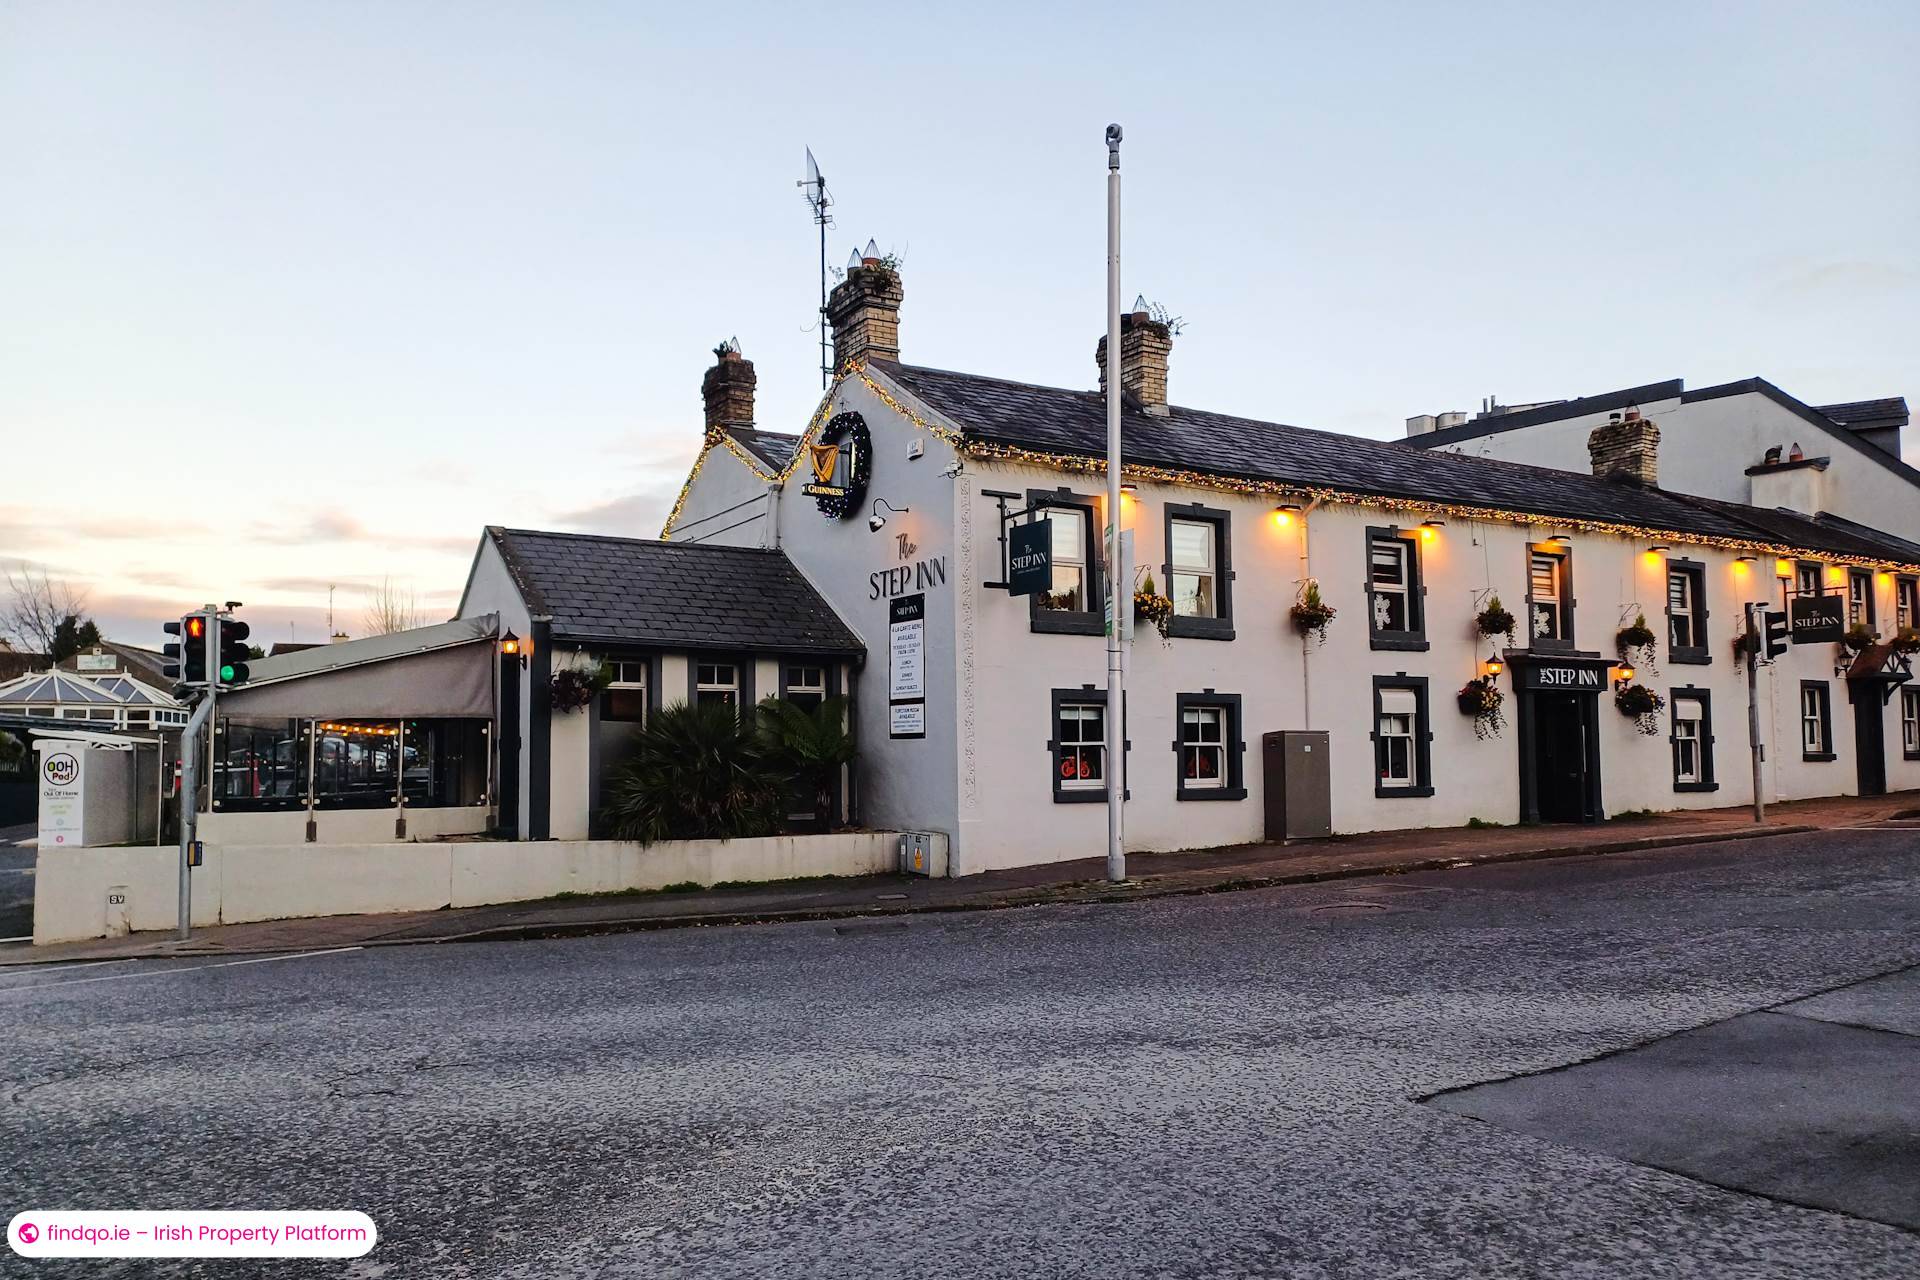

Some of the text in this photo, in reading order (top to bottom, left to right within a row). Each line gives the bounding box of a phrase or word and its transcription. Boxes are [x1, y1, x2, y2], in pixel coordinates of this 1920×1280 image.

[807, 484, 844, 496] GUINNESS
[896, 533, 917, 560] The
[1011, 551, 1047, 570] STEP INN
[869, 555, 945, 601] STEP INN
[1795, 616, 1840, 628] STEP INN
[1540, 667, 1598, 686] THE STEP INN
[110, 895, 125, 904] SV
